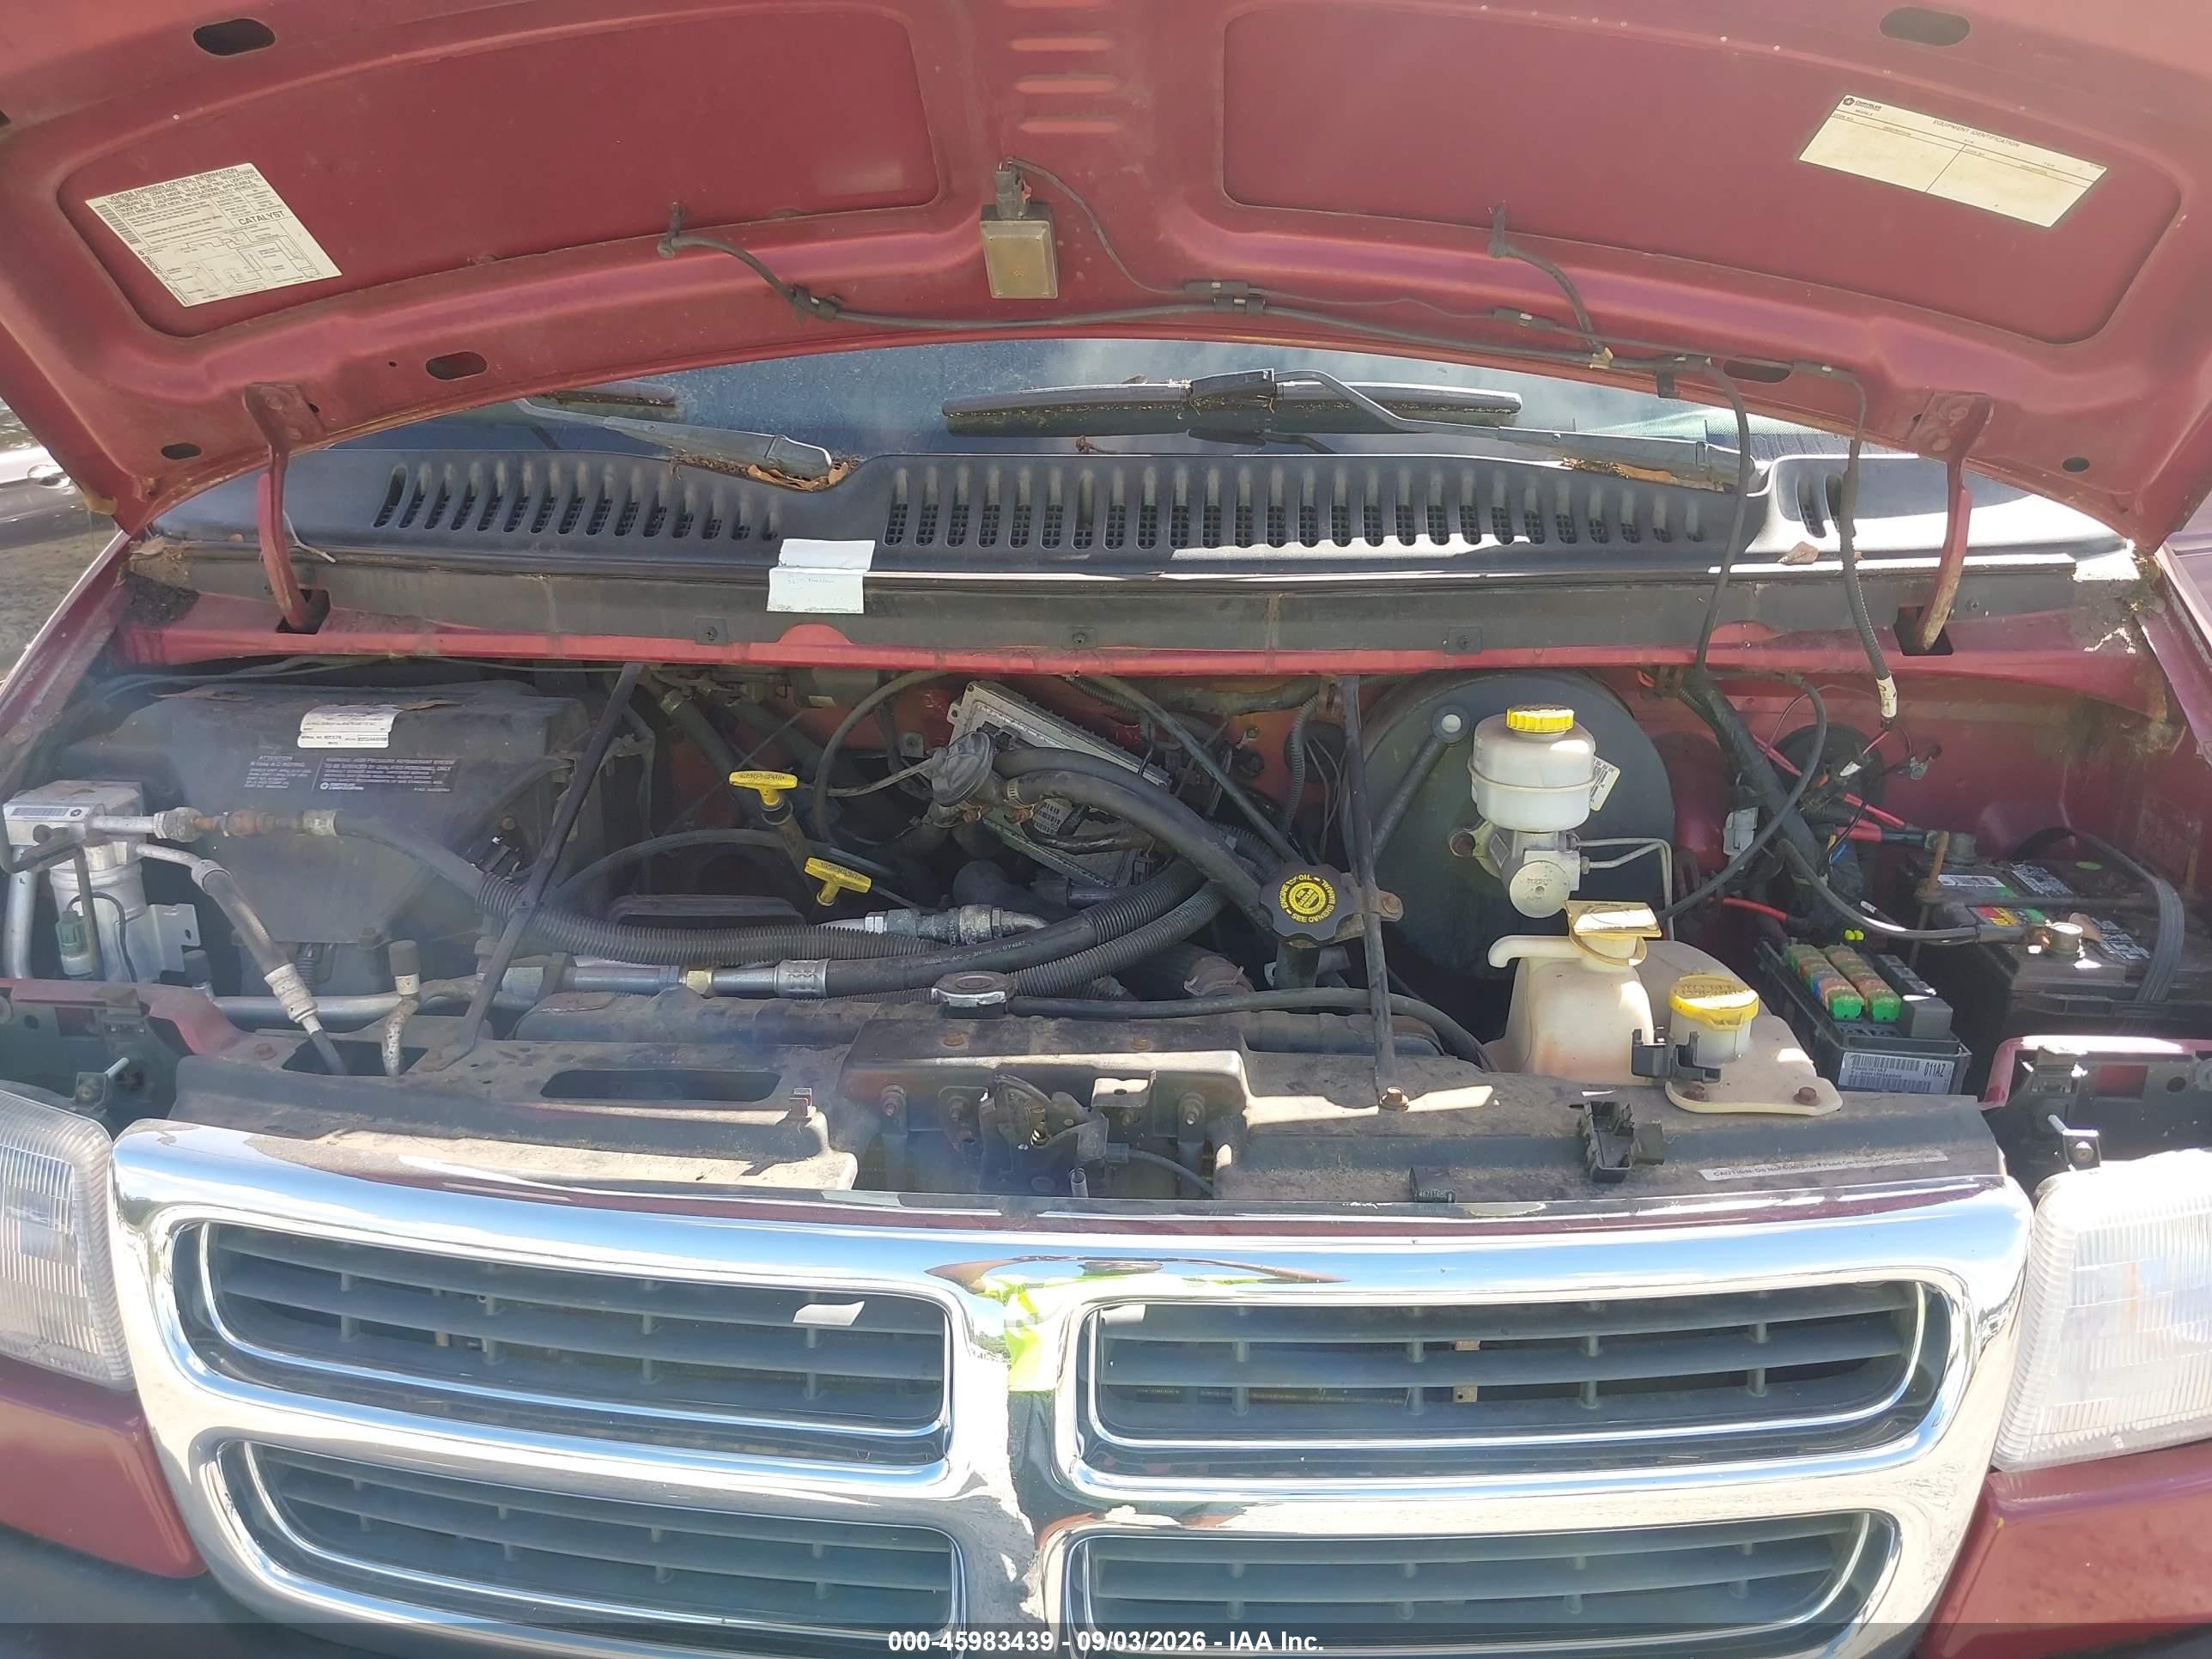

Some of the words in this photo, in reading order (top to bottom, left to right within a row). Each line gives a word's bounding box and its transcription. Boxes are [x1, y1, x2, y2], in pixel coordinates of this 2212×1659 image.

[1933, 119, 1971, 132] EQUIPMENT
[1970, 129, 2021, 148] IDENTIFICATION
[106, 191, 134, 201] VEHICLE
[163, 177, 195, 188] CONTROL
[192, 167, 238, 181] INFORMATION
[239, 210, 285, 226] CATALYST
[1279, 884, 1289, 908] ENGINE
[1291, 913, 1308, 923] SEE
[1322, 878, 1335, 904] MANUAL
[1923, 1061, 1947, 1078] 011AZ
